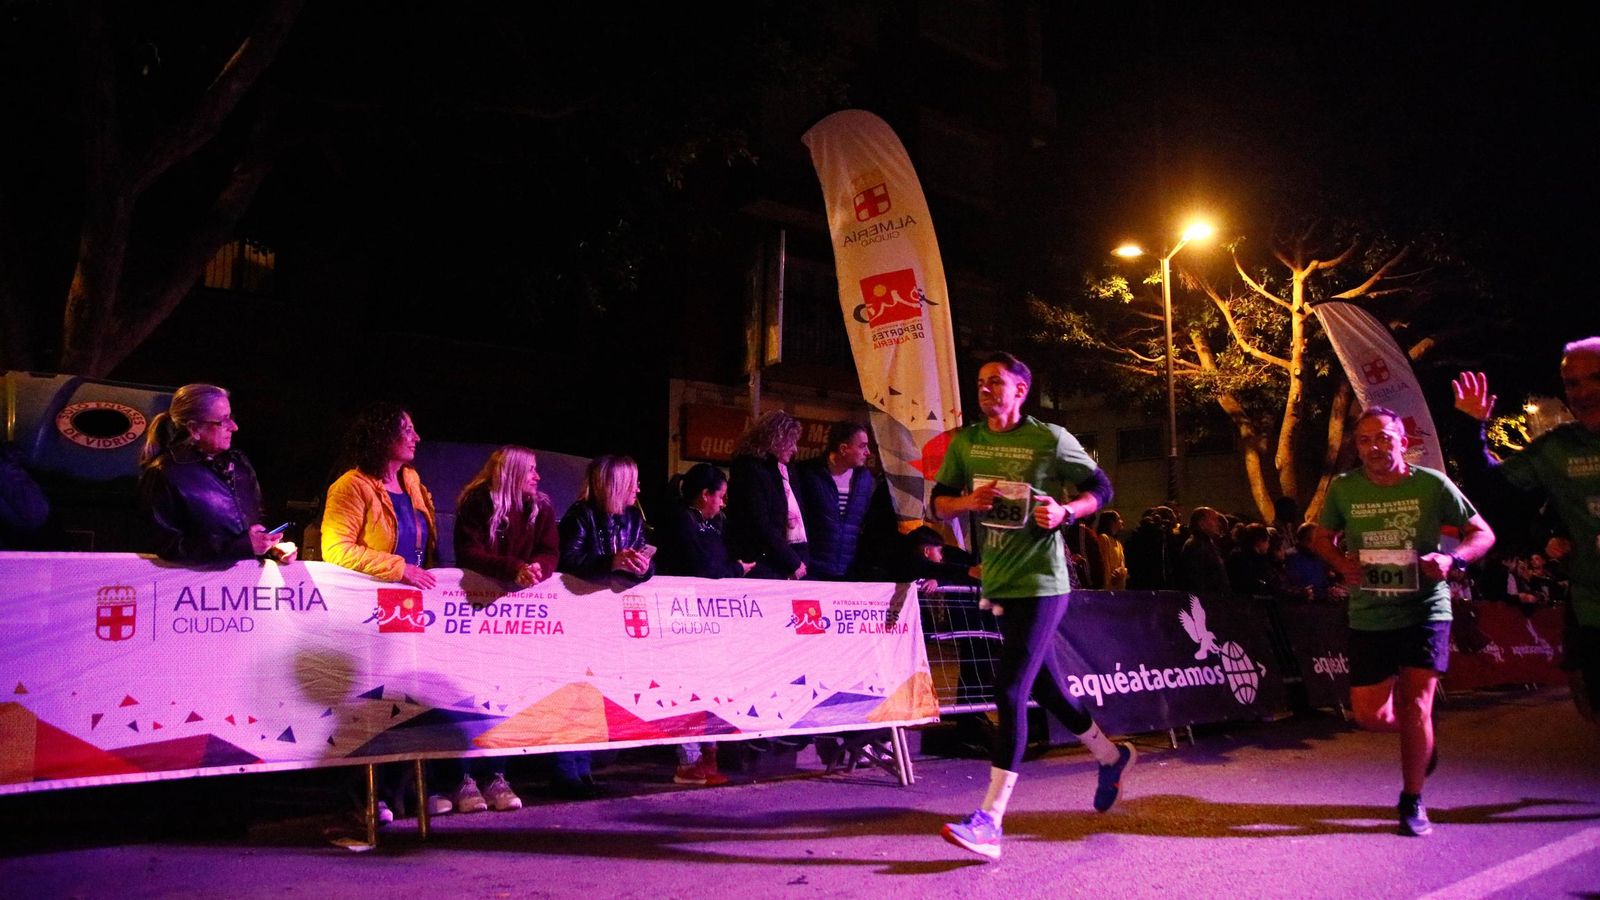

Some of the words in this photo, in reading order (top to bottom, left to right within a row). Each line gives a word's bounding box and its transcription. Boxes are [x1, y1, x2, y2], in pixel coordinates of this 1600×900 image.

[59, 403, 89, 419] SOLO
[96, 403, 145, 425] ENVASES
[64, 428, 81, 440] DE
[86, 432, 137, 447] VIDRIO
[701, 436, 735, 456] que
[1368, 570, 1404, 585] 801
[174, 582, 328, 611] ALMERÍA
[444, 602, 548, 618] DEPORTES
[671, 594, 763, 618] ALMERÍA
[835, 609, 899, 621] DEPORTES
[172, 617, 254, 634] CIUDAD
[445, 619, 471, 634] DE
[478, 620, 564, 635] ALMERIA
[671, 621, 720, 634] CIUDAD
[838, 622, 854, 634] DE
[859, 622, 909, 634] ALMERIA
[1312, 650, 1349, 680] aquéat
[1067, 663, 1225, 706] aquéatacamos
